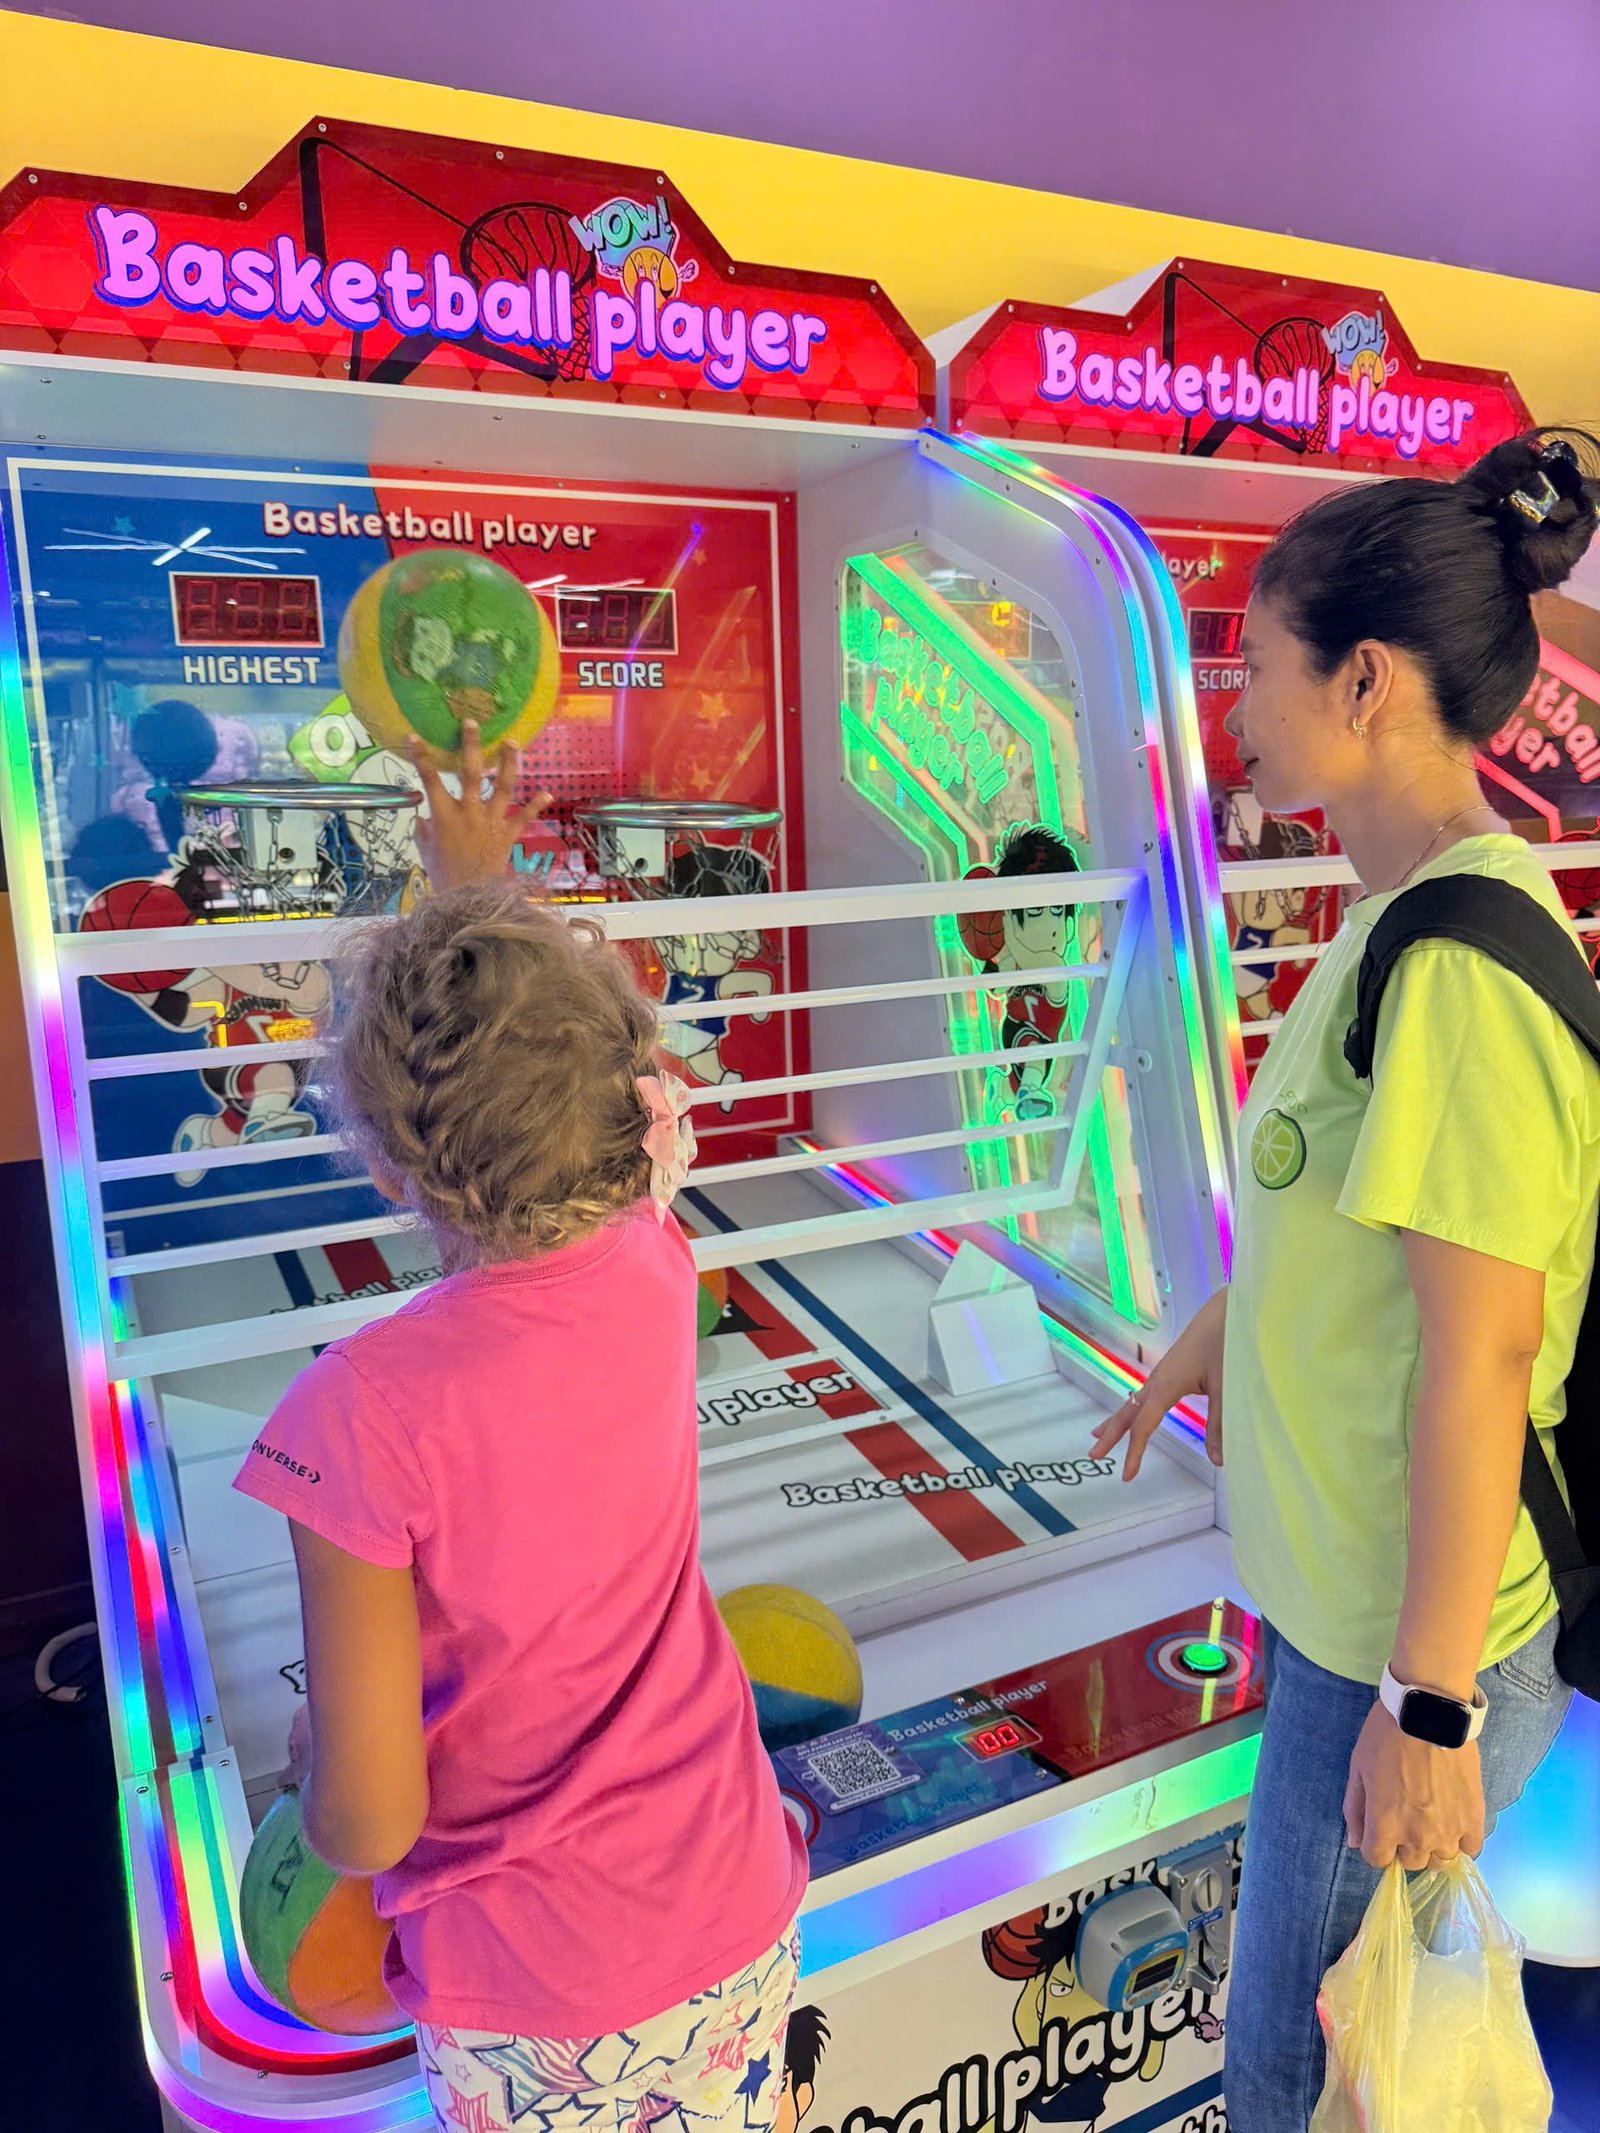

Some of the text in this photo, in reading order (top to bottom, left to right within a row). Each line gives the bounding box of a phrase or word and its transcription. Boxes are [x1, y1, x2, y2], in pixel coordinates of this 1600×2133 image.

[568, 196, 675, 252] WOW!
[93, 204, 828, 391] Basketball player
[1037, 325, 1475, 460] Basketball player
[262, 501, 597, 551] Basketball player
[182, 655, 321, 685] HIGHEST
[578, 660, 665, 689] SCORE
[860, 604, 1009, 804] Basketball
[871, 676, 965, 791] player
[709, 1370, 855, 1426] player
[251, 1439, 309, 1478] ONVERSE
[781, 1457, 1116, 1507] Basketball player
[886, 1680, 1049, 1743] Basketball player
